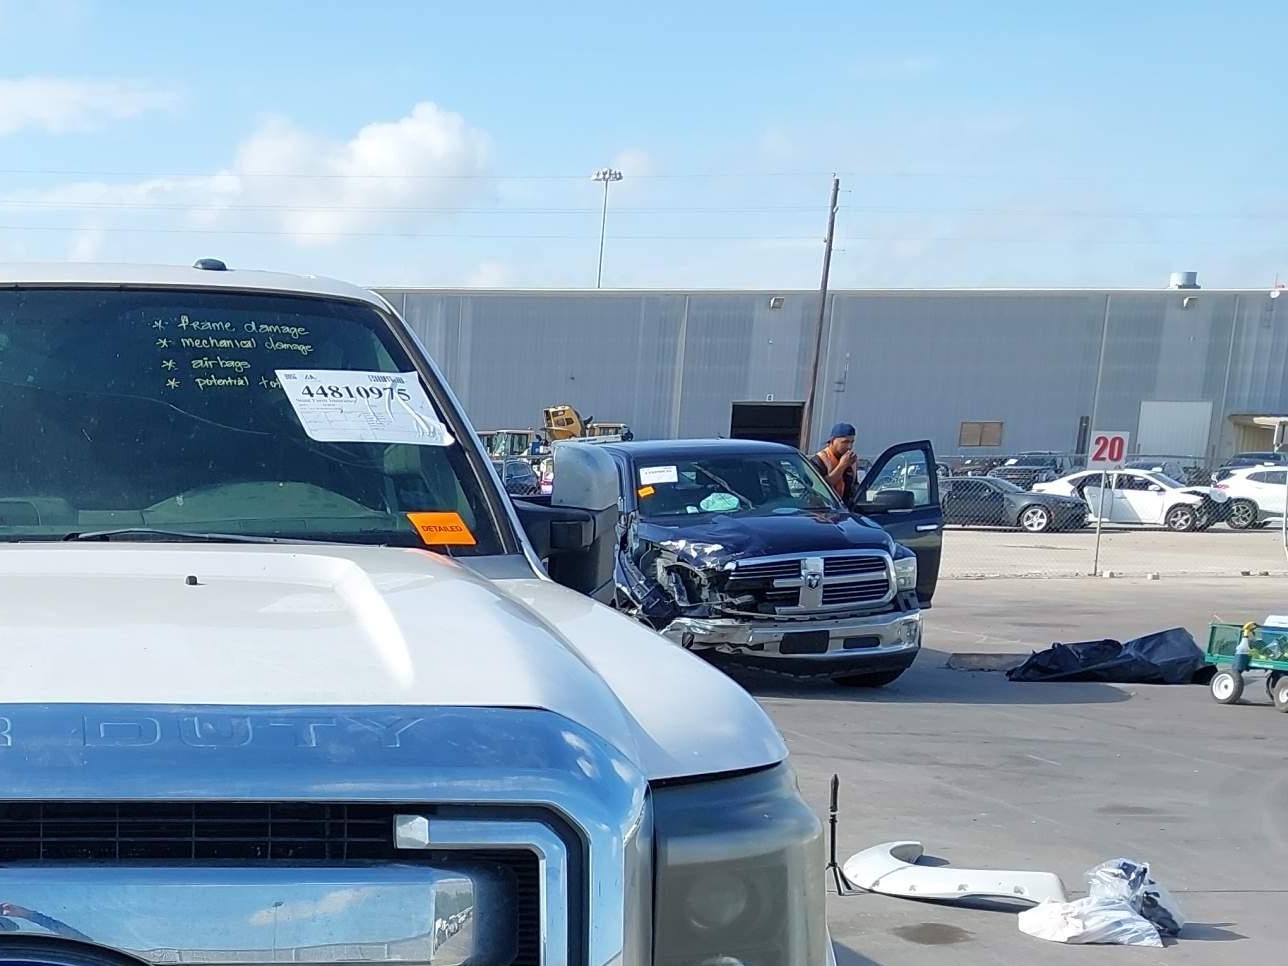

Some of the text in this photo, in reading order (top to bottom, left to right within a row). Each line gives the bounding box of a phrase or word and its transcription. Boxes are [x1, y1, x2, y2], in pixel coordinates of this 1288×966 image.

[244, 321, 310, 338] damage
[181, 337, 314, 355] mechanical damage
[195, 375, 249, 391] potential
[301, 384, 411, 401] 44810975
[1091, 436, 1125, 462] 20
[83, 715, 424, 749] DUTY
